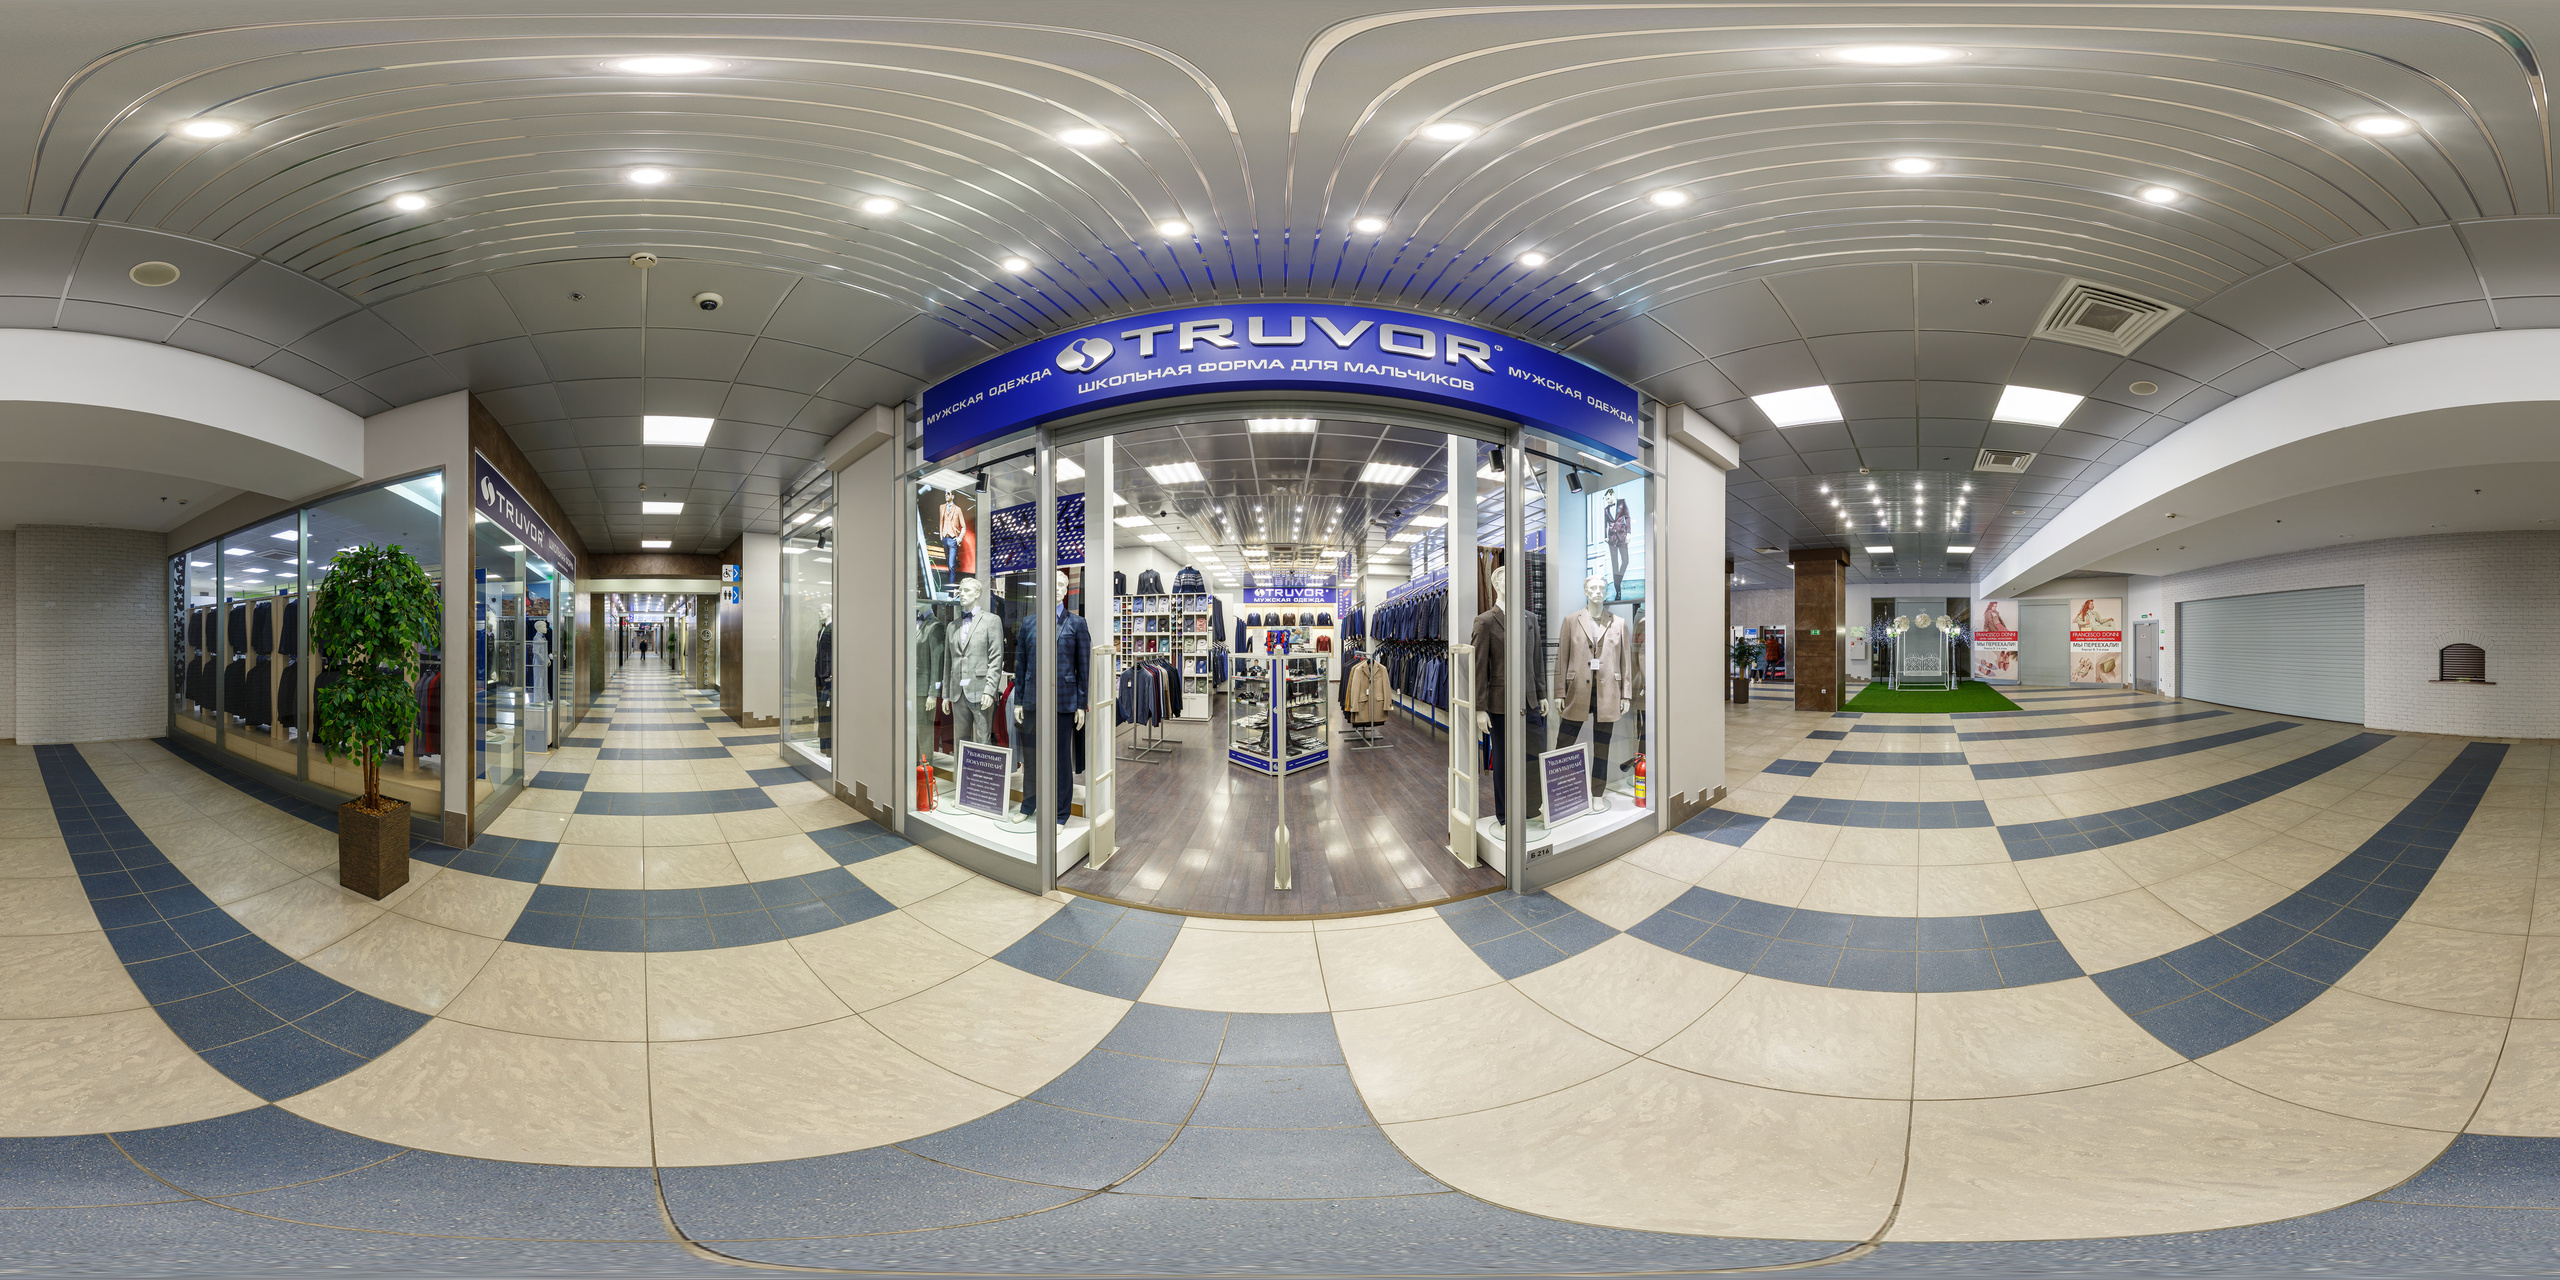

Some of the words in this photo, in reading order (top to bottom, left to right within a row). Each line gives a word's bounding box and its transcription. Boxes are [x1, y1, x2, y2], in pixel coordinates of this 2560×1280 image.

[1121, 316, 1496, 373] TRUVOR
[1078, 364, 1192, 394] ШКОЛЬНАЯ
[1198, 359, 1285, 373] ФОРМА
[1291, 359, 1338, 372] ДЛЯ
[1343, 361, 1475, 391] МАЛЬЧИКОВ
[926, 392, 983, 425] МУЖСКАЯ
[989, 368, 1052, 397] ОДЕЖДА
[1508, 366, 1582, 400] МУЖСКАЯ
[1587, 395, 1634, 424] ОДЕЖДА
[496, 490, 543, 548] TRUVOR
[1265, 588, 1324, 597] TRUVOR
[966, 749, 1002, 762] Уважаемые
[1548, 754, 1580, 767] Уважаемые
[965, 758, 1003, 770] покупатели!
[1548, 760, 1582, 775] покупатели!
[1537, 848, 1550, 857] 216
